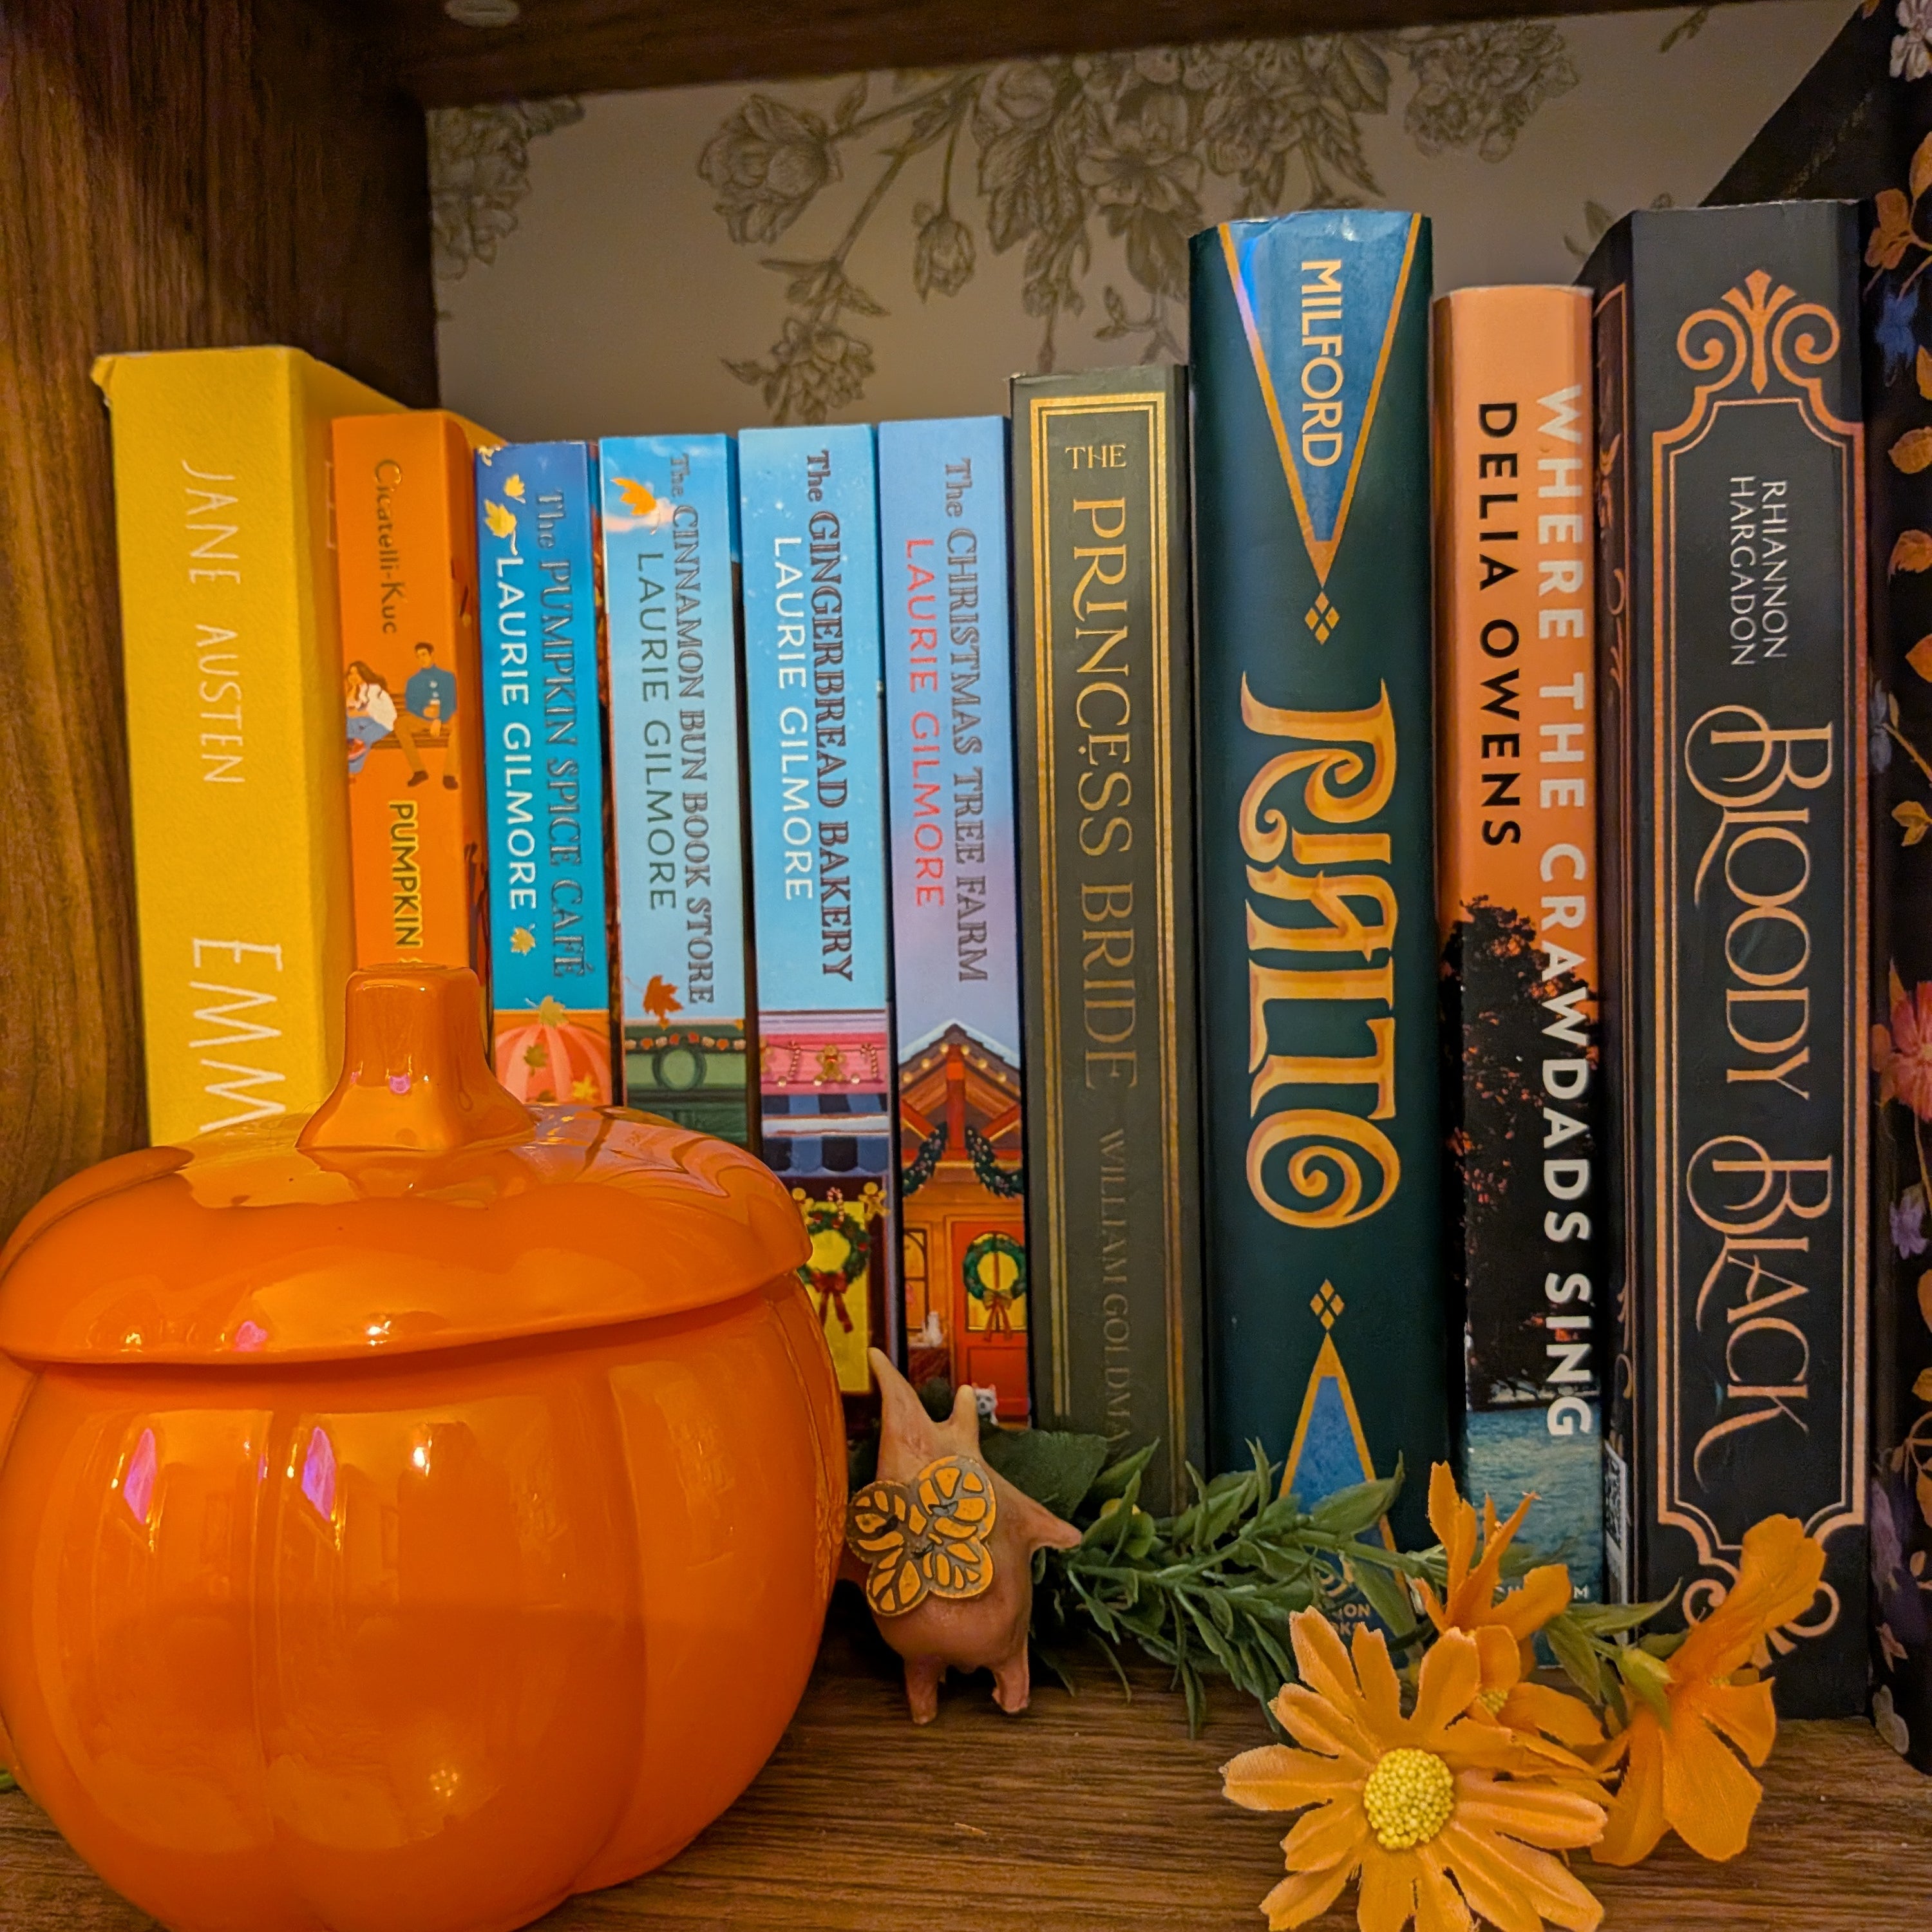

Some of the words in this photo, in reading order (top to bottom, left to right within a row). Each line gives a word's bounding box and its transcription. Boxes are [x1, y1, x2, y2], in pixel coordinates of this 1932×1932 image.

[1300, 259, 1344, 467] MILFORD
[181, 460, 240, 585] JANE
[535, 489, 565, 549] The
[670, 454, 690, 497] The
[807, 450, 831, 502] The
[945, 458, 971, 517] The
[1065, 445, 1127, 469] THE
[1478, 402, 1519, 591] DELIA
[1537, 384, 1585, 639] WHERE
[374, 459, 406, 634] Cicatelli-Kuc
[673, 506, 705, 699] CINNAMON
[774, 537, 806, 689] LAURIE
[905, 539, 938, 692] LAURIE
[1730, 475, 1757, 666] HARGADON
[1761, 480, 1788, 659] RHIANNON
[195, 624, 245, 784] AUSTEN
[495, 558, 531, 706] LAURIE
[538, 560, 576, 746] PUMPKIN
[637, 554, 669, 701] LAURIE
[808, 511, 848, 808] GINGERBREAD
[947, 528, 983, 755] CHRISTMAS
[1073, 497, 1133, 857] PRINCESS
[547, 759, 582, 866] SPICE
[679, 709, 707, 782] BUN
[779, 706, 813, 900] GILMORE
[911, 711, 944, 907] GILMORE
[1480, 619, 1520, 846] OWENS
[1538, 672, 1585, 809] THE
[388, 799, 423, 950] PUMPKIN
[501, 723, 536, 909] GILMORE
[644, 721, 676, 909] GILMORE
[683, 791, 711, 889] BOOK
[953, 766, 985, 864] TREE
[551, 879, 594, 977] CAFÉ
[687, 897, 714, 1004] STORE
[819, 820, 853, 981] BAKERY
[956, 876, 988, 982] FARM
[1684, 705, 1833, 1100] BLOODY
[189, 938, 285, 1133] EMM
[1081, 882, 1138, 1089] BRIDE
[1540, 843, 1591, 1242] CRAWDADS
[1099, 1128, 1128, 1285] WILLIAM
[1545, 1273, 1593, 1435] SING
[1686, 1135, 1833, 1493] BLACK
